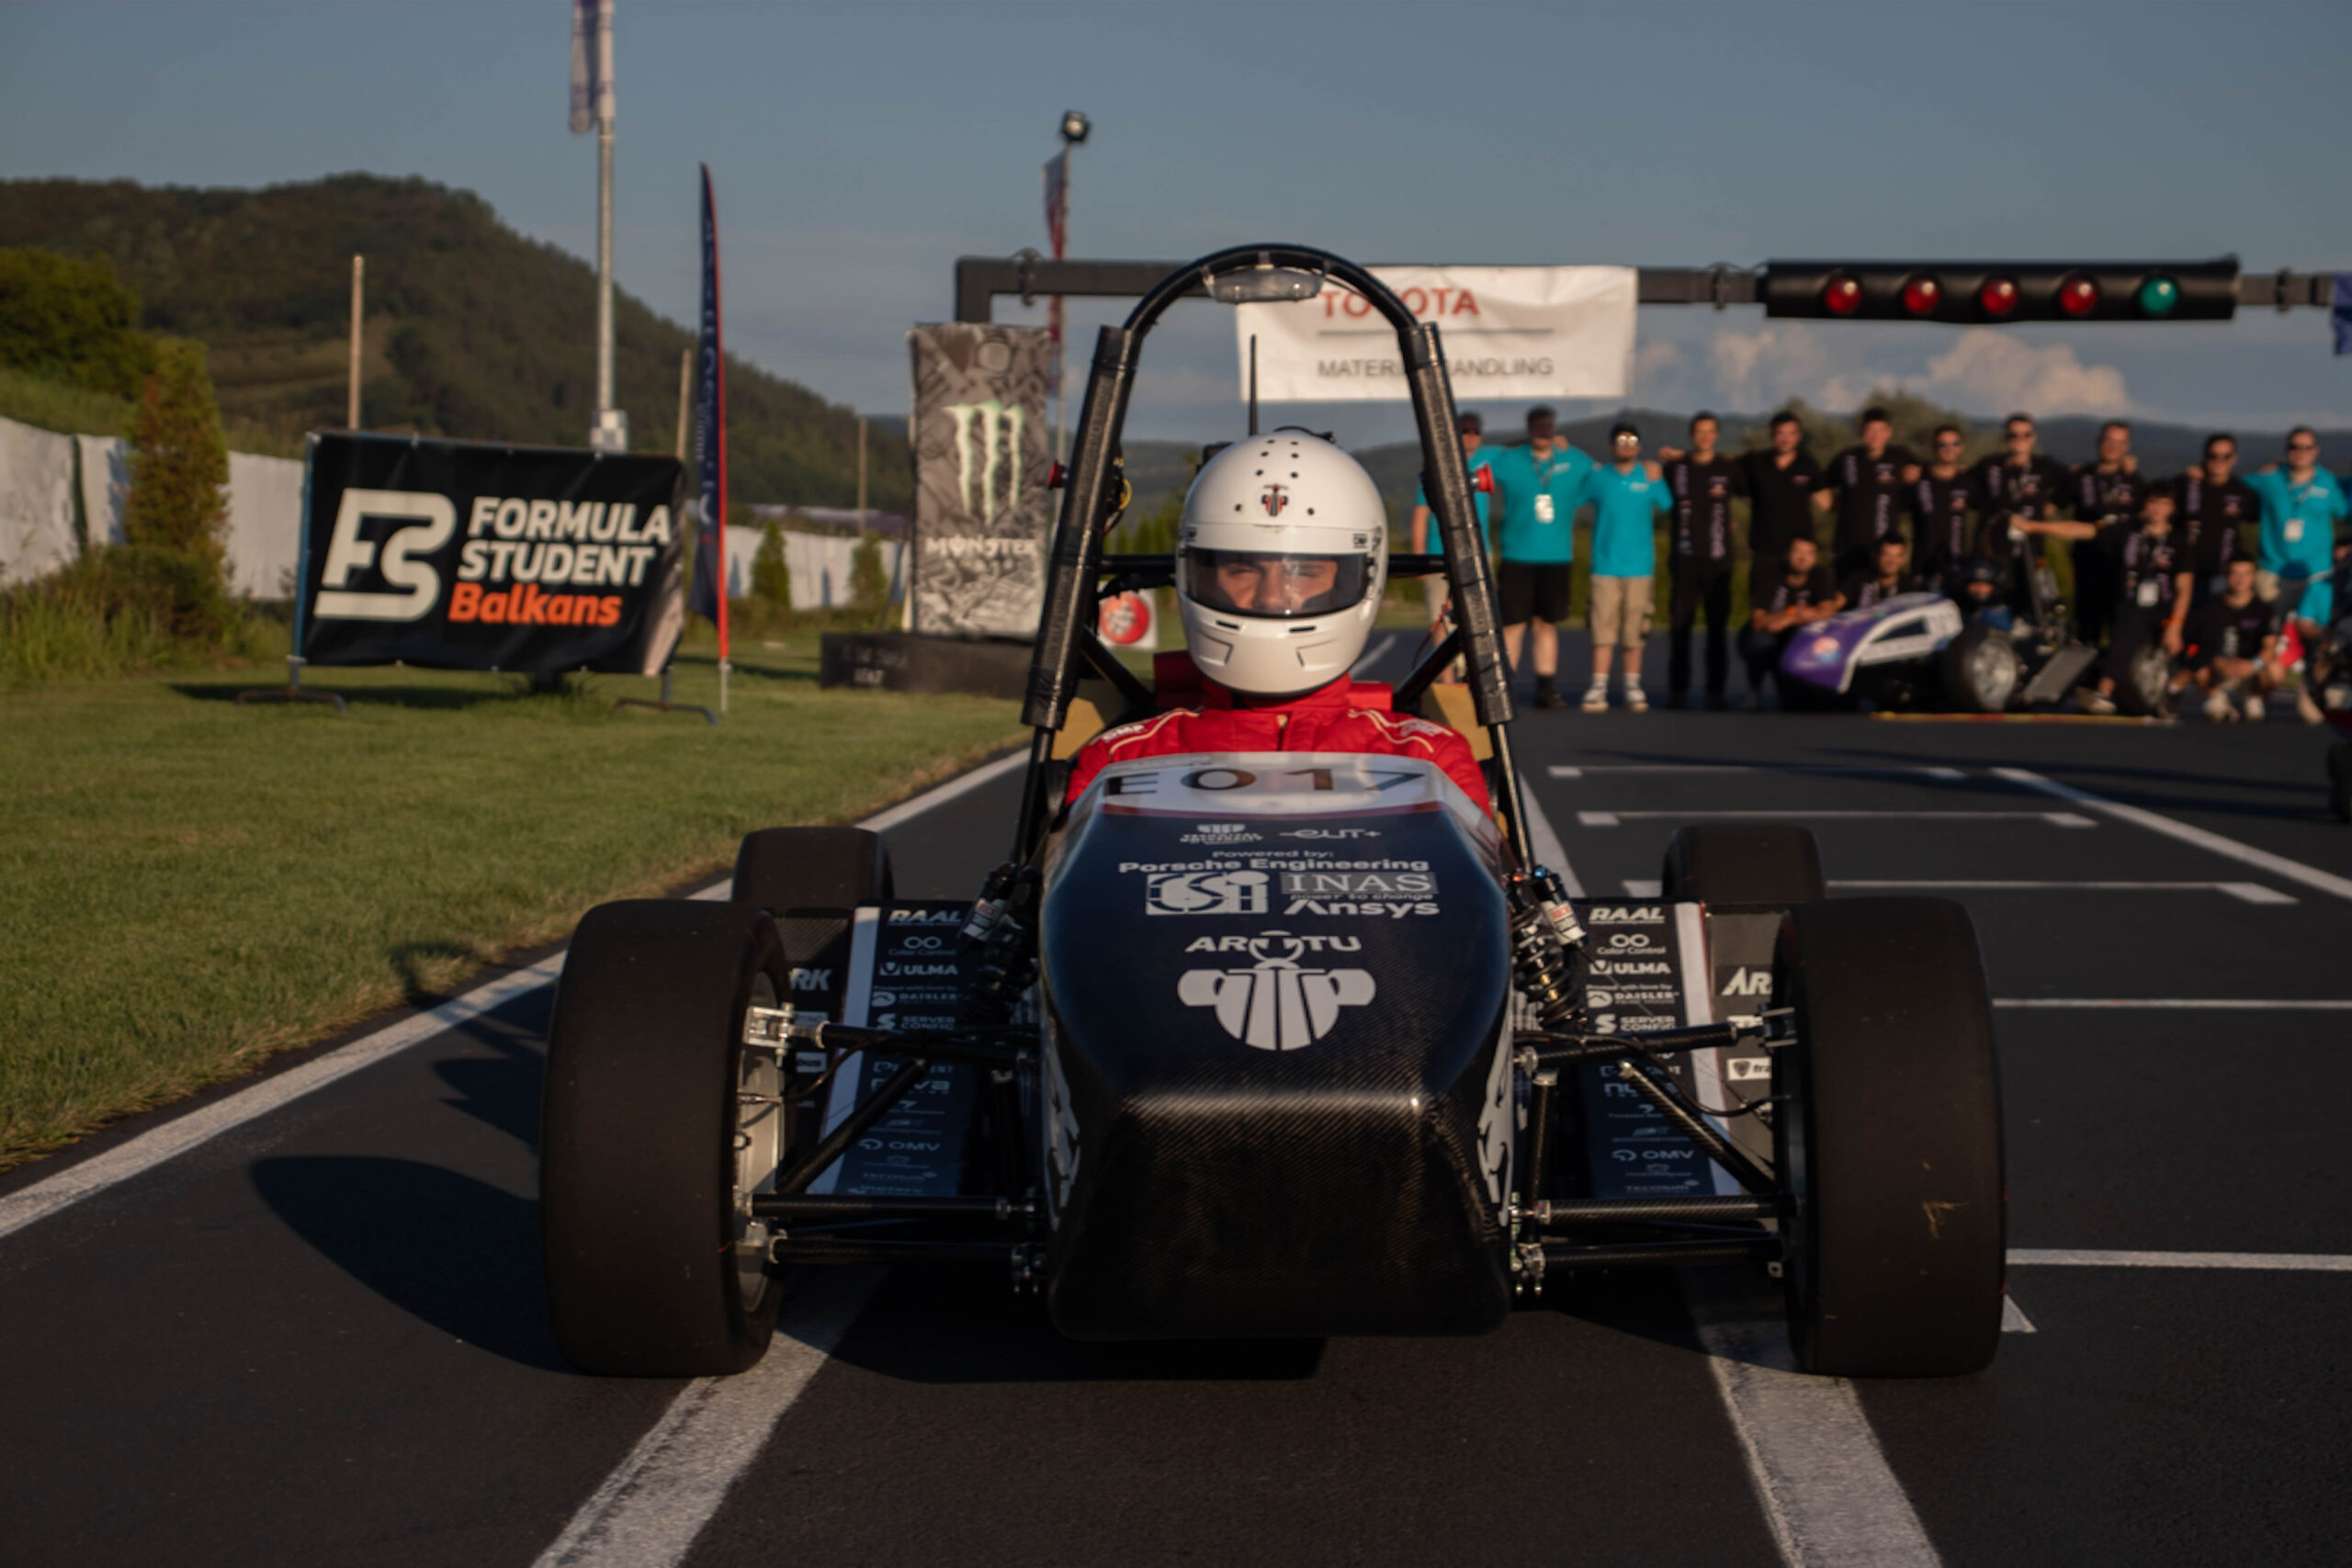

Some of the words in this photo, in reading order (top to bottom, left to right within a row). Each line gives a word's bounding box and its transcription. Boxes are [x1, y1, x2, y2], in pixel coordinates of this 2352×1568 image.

[1317, 287, 1480, 318] TOOTA
[1317, 359, 1407, 378] MATERI
[1451, 356, 1555, 378] ANDLING
[467, 496, 672, 545] FORMULA
[458, 539, 655, 586] STUDENT
[447, 581, 623, 626] Balkans
[1119, 860, 1241, 873] Porsche
[1250, 858, 1430, 872] Engineering
[1288, 874, 1432, 893] INAS
[888, 909, 962, 923] RAAL
[1283, 900, 1441, 919] Ansys
[1589, 907, 1665, 921] RAAL
[903, 964, 959, 975] ULMA
[1614, 962, 1671, 975] ULMA
[888, 1141, 941, 1151] OMV
[1642, 1149, 1694, 1159] OMV
